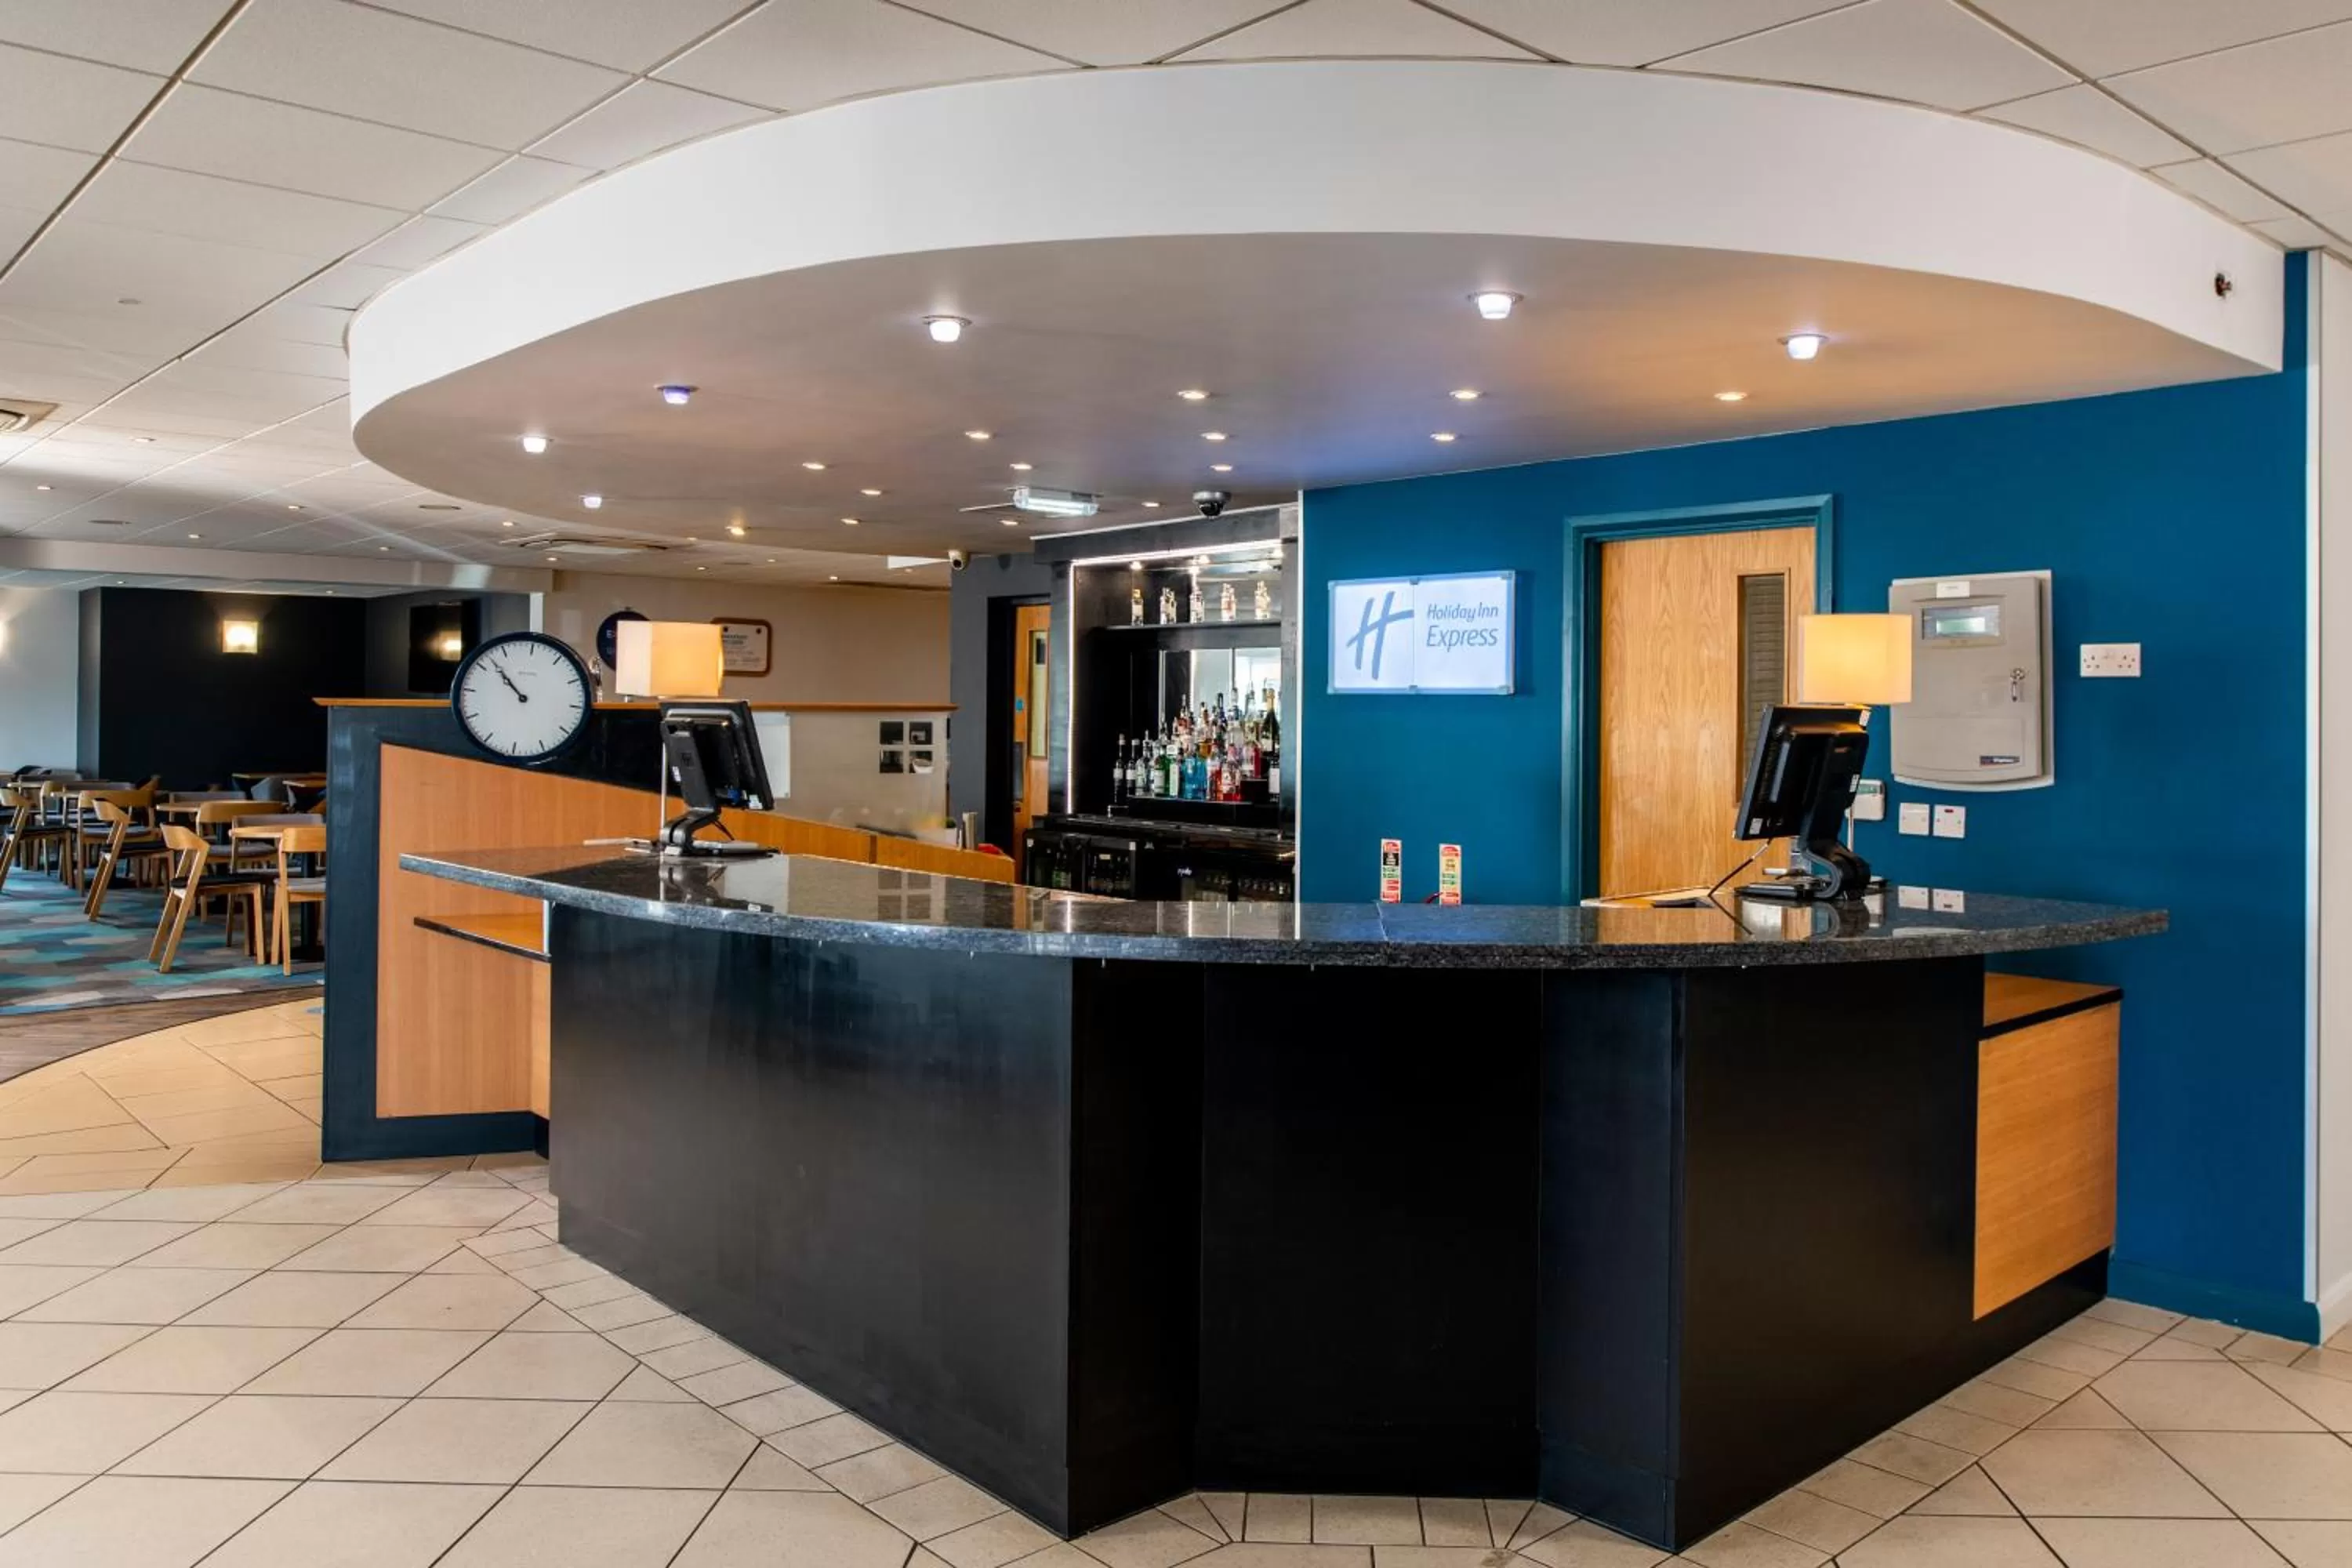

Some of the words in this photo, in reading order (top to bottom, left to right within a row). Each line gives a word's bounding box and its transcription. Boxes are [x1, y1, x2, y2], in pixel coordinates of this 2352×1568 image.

[1426, 603, 1475, 622] Holiday
[1477, 602, 1498, 619] Inn
[1426, 625, 1499, 652] Express
